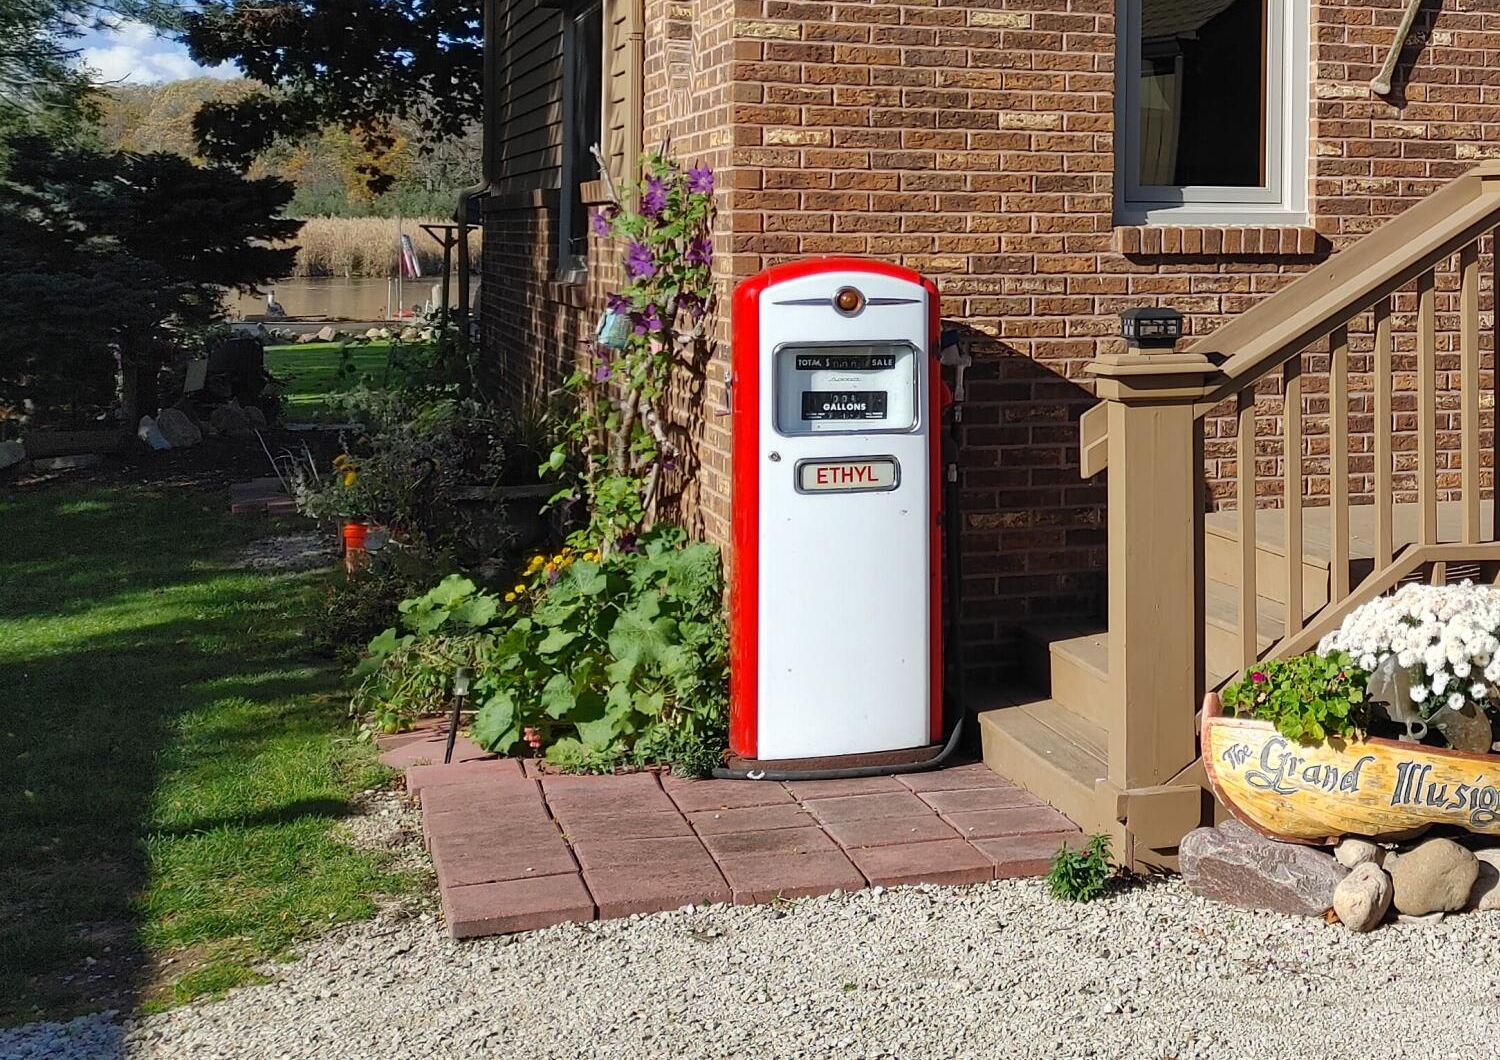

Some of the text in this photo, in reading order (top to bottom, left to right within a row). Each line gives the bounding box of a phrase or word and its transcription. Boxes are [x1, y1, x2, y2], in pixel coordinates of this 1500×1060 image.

[798, 358, 822, 367] TOTAL
[871, 358, 893, 366] SALE
[823, 403, 866, 411] GALLONS
[816, 465, 879, 484] ETHYL
[1222, 743, 1253, 770] The
[1244, 735, 1377, 795] Grand
